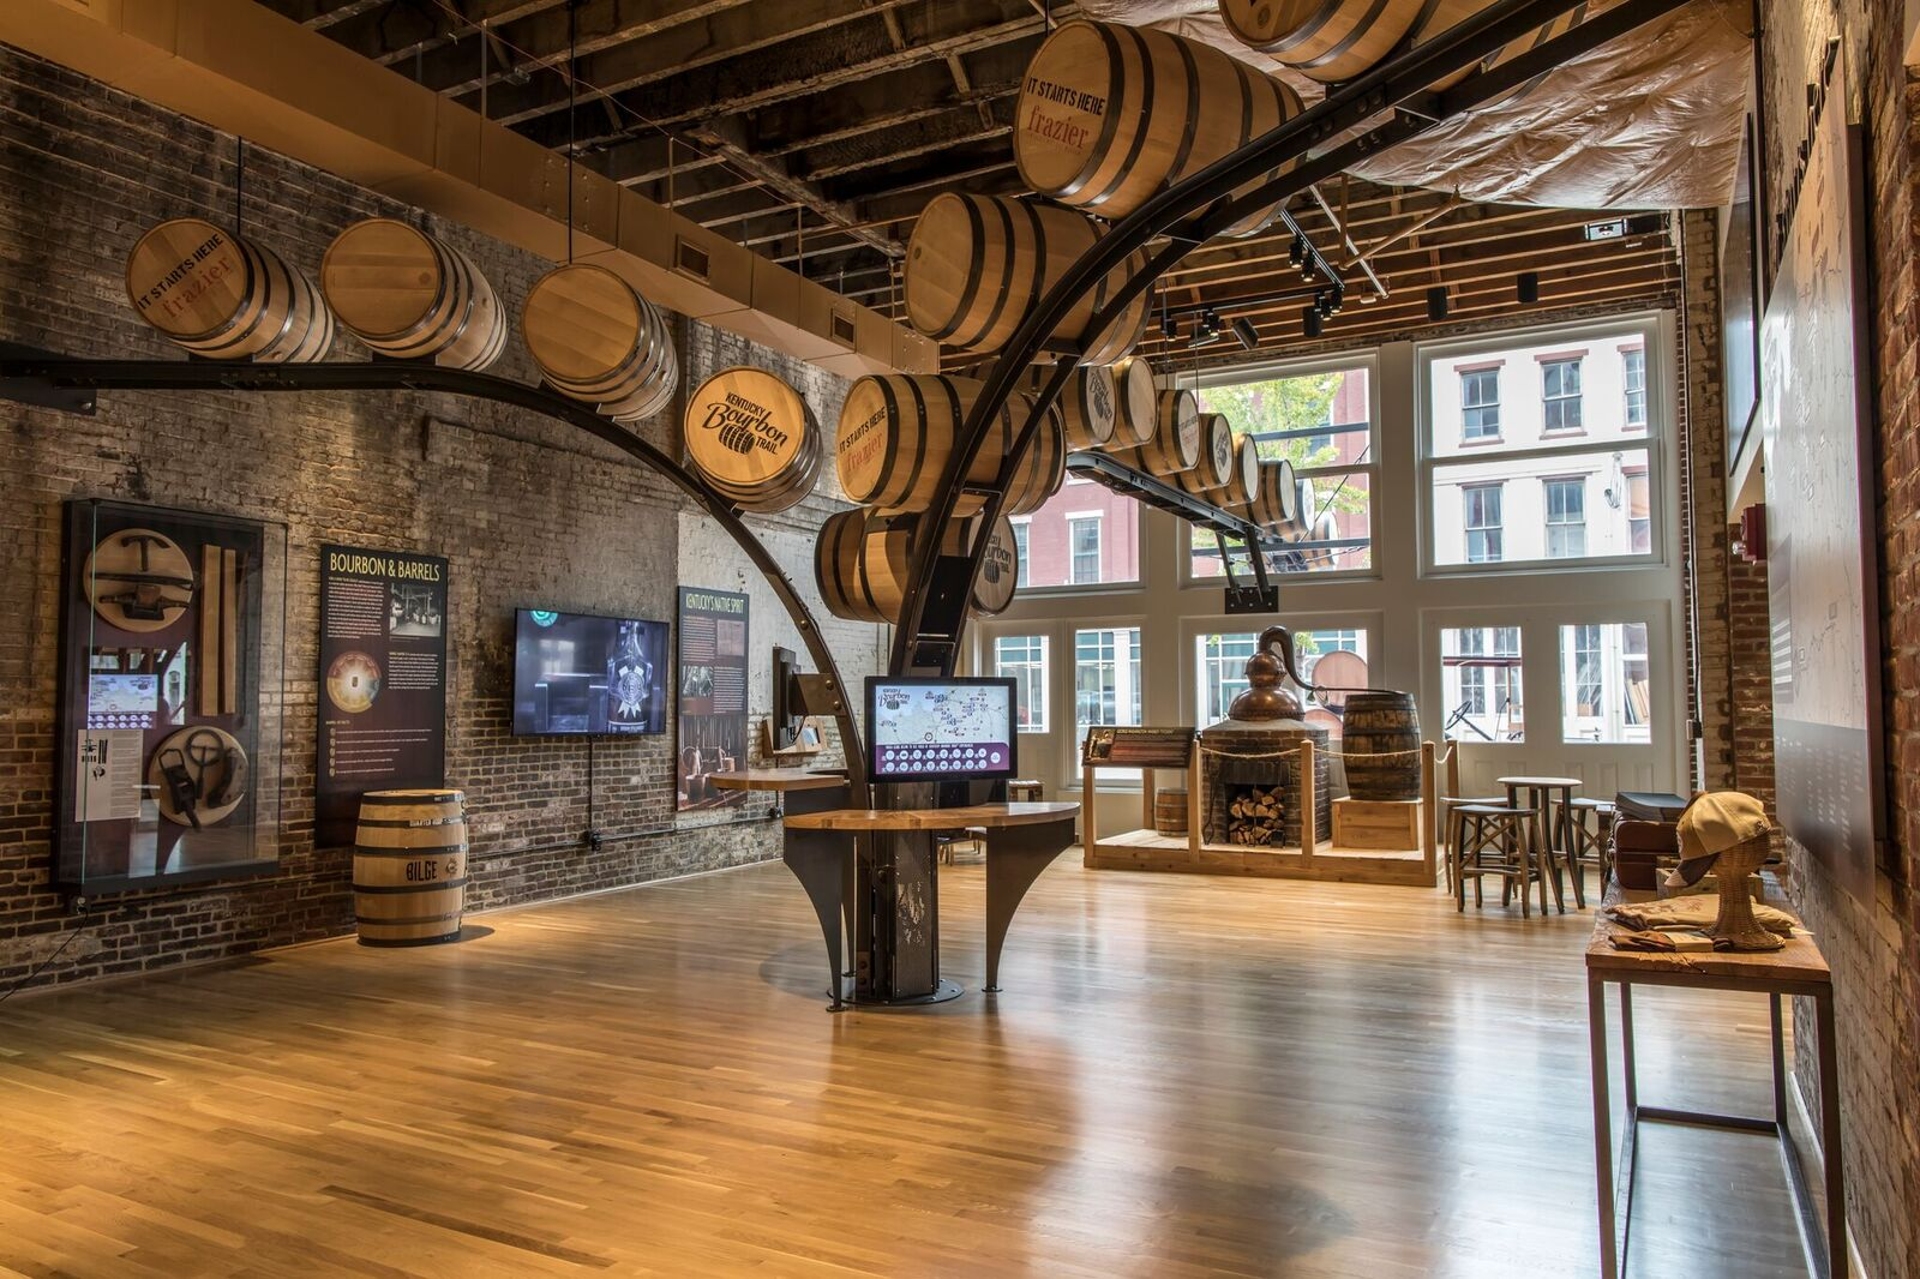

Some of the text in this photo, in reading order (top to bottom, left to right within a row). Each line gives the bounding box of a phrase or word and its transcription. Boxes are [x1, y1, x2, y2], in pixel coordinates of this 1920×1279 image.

[1027, 77, 1106, 116] IT STARTS HERE
[1027, 104, 1089, 150] frazier
[138, 233, 223, 310] IT STARTS HERE
[162, 257, 231, 318] frazier
[725, 392, 766, 417] KENTUCKY
[702, 402, 788, 448] Bourbon
[839, 406, 886, 454] IT STARTS HERE
[755, 436, 779, 455] TRAIL
[847, 432, 883, 471] frazier
[330, 552, 440, 582] BOURBON & BARRELS
[406, 860, 438, 881] BILGE
